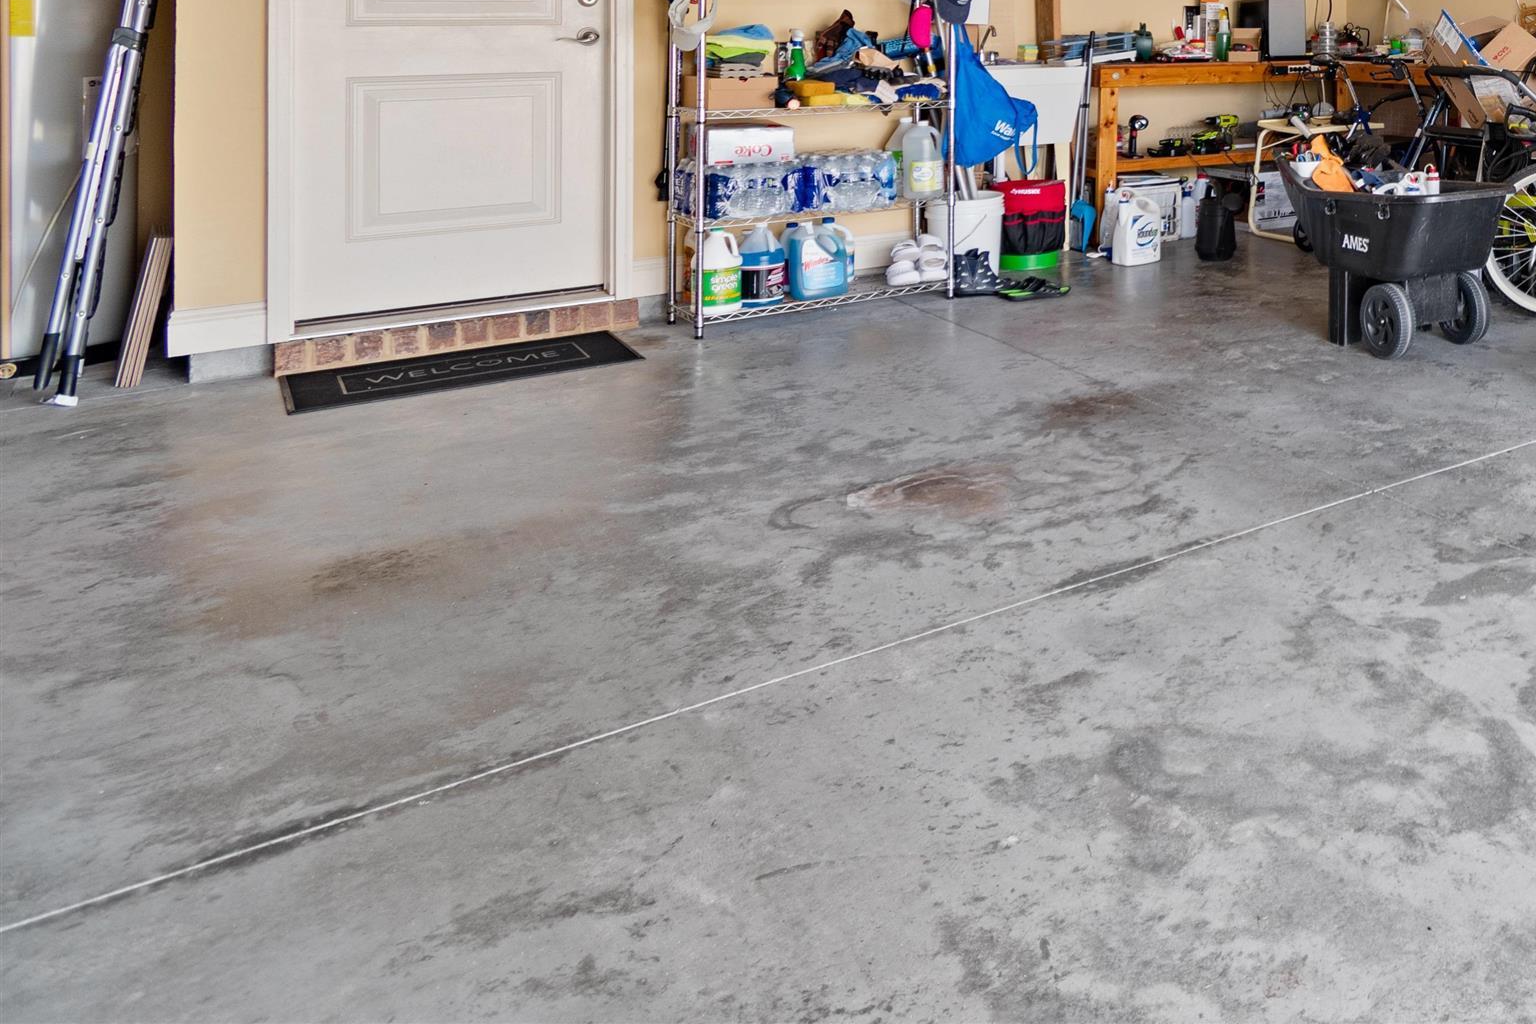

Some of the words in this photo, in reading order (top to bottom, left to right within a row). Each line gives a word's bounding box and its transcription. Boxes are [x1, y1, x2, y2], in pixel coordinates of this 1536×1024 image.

[735, 143, 773, 157] Coke
[1341, 233, 1370, 253] AMES
[710, 273, 738, 285] simple
[710, 282, 738, 293] green
[364, 349, 562, 384] WELCOME
